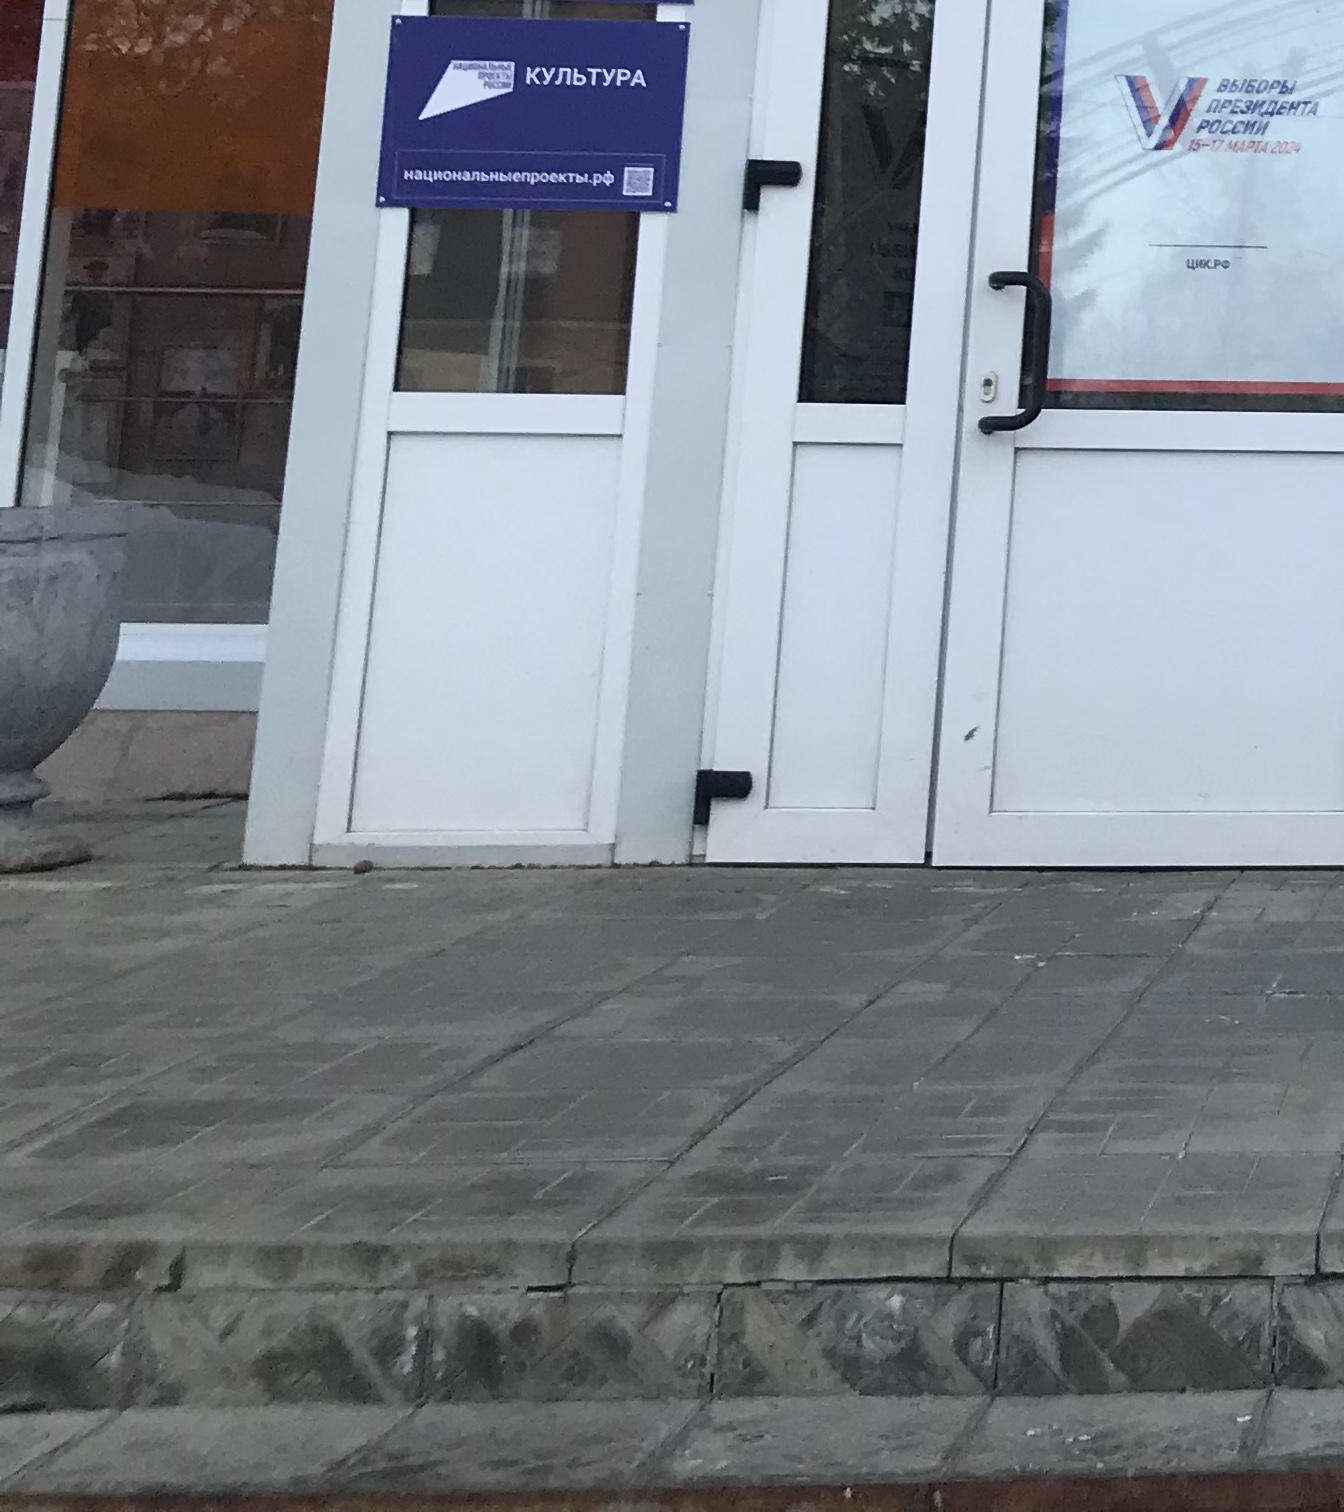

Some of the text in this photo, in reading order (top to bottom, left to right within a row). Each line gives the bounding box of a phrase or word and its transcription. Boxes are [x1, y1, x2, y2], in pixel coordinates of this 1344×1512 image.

[525, 66, 647, 87] КУЛЬТУРА
[1216, 78, 1297, 95] ВЫБОРЫ
[1205, 99, 1319, 117] ПРЕЗИДЕНТА
[1195, 120, 1270, 136] РОССИИ
[1227, 140, 1267, 154] МАРТА
[1270, 140, 1301, 155] 2024
[403, 168, 615, 187] национальныепроекты.рф
[1186, 258, 1231, 270] ЦИК.РФ
